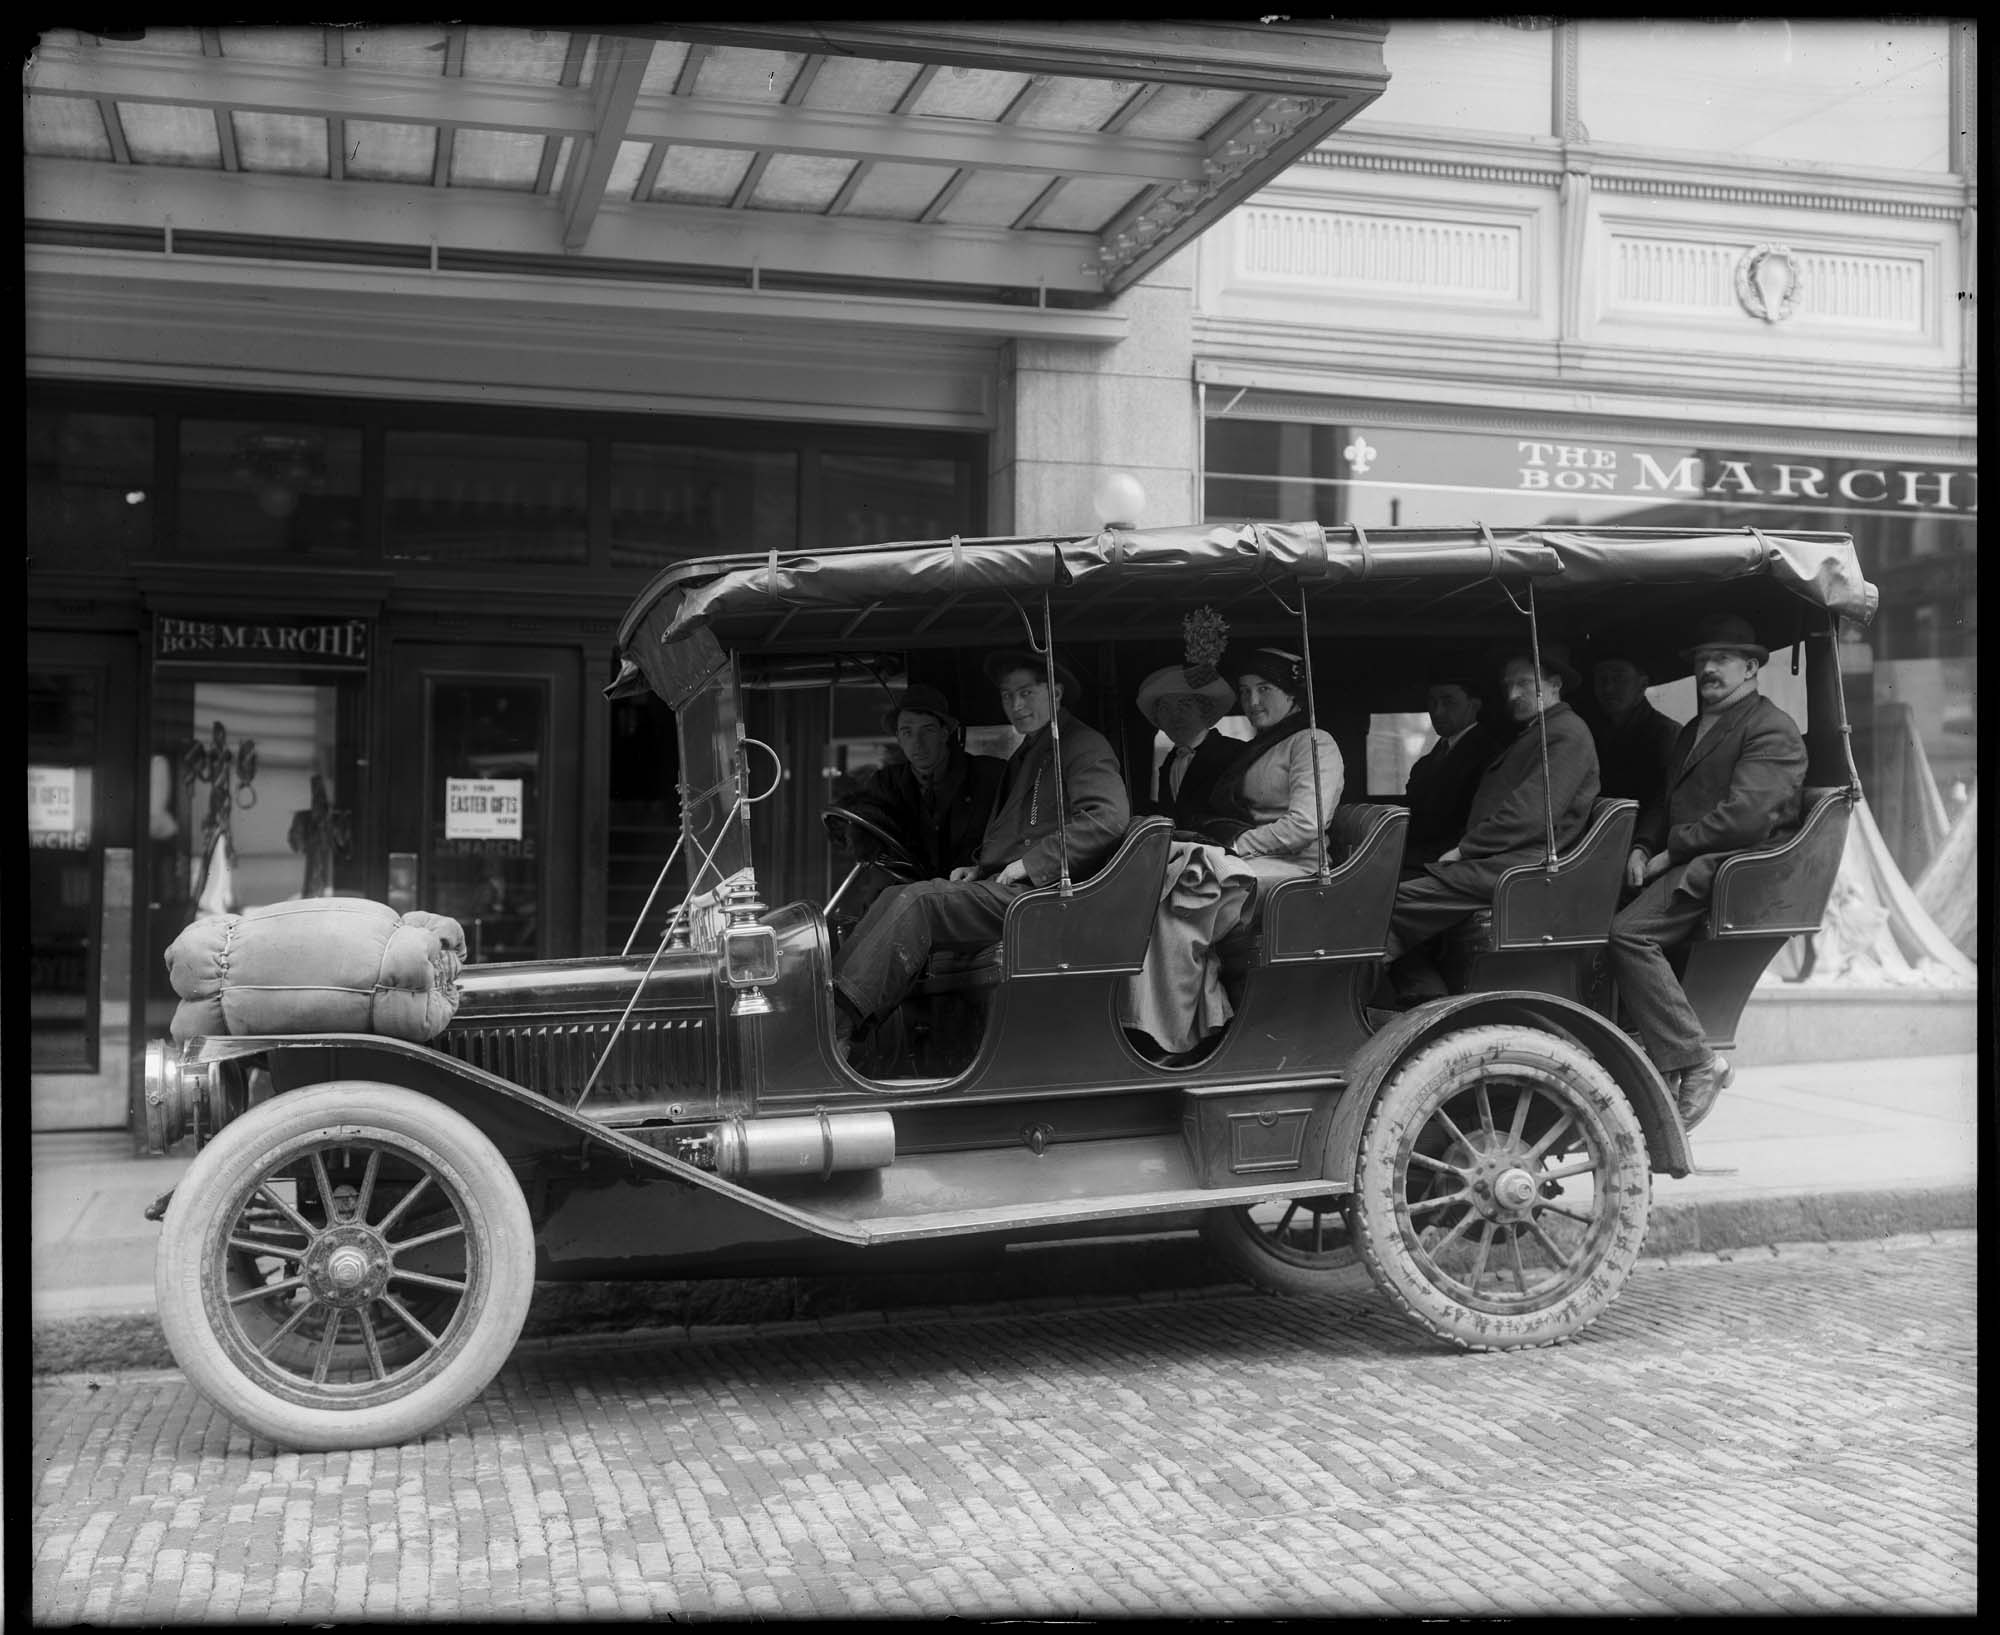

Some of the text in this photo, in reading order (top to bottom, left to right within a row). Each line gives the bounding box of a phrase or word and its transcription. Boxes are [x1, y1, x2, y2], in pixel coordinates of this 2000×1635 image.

[1518, 441, 1617, 470] THE
[1518, 468, 1618, 490] BON
[1632, 452, 1977, 511] MARCH
[160, 616, 216, 635] THE
[161, 635, 215, 654] BON
[219, 620, 366, 660] MARCHÉ
[450, 795, 518, 814] EASTER GIFTS
